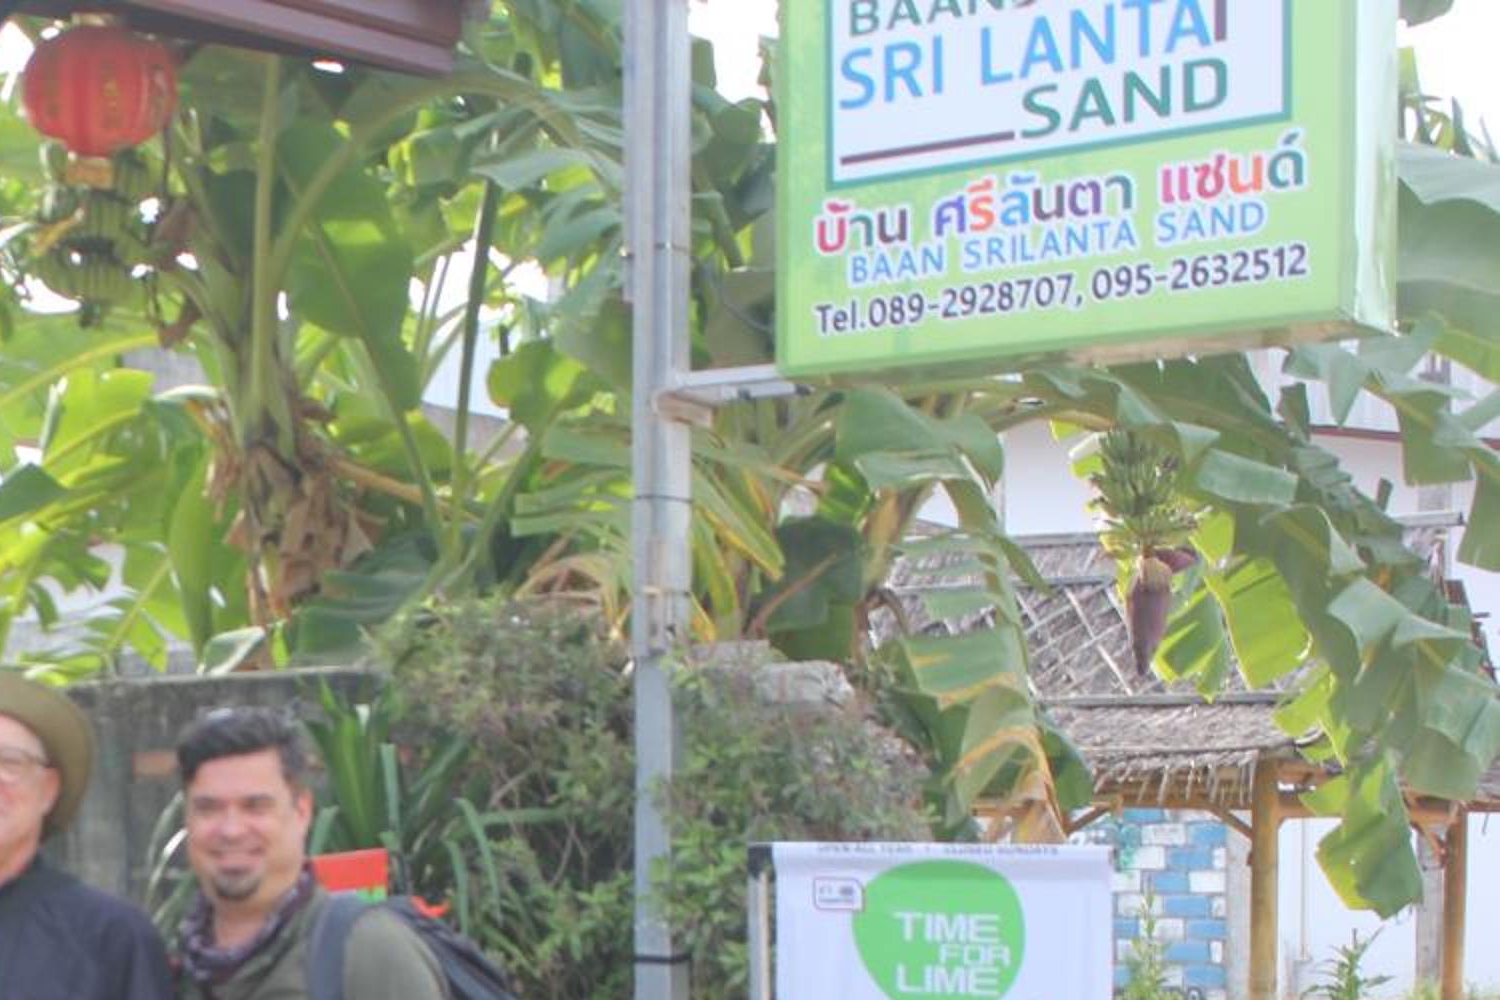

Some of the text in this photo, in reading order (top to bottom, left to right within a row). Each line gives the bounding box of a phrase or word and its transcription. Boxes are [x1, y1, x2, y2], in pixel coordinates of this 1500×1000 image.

[840, 0, 1212, 110] SRI LANTA
[1021, 58, 1228, 139] SAND
[817, 132, 1304, 253] บ้าน ศรีลันตา แซนด์
[852, 202, 1265, 283] BAAN SRILANTA SAND
[893, 911, 999, 942] TIME
[939, 943, 1011, 967] FOR
[896, 963, 999, 997] LIME
